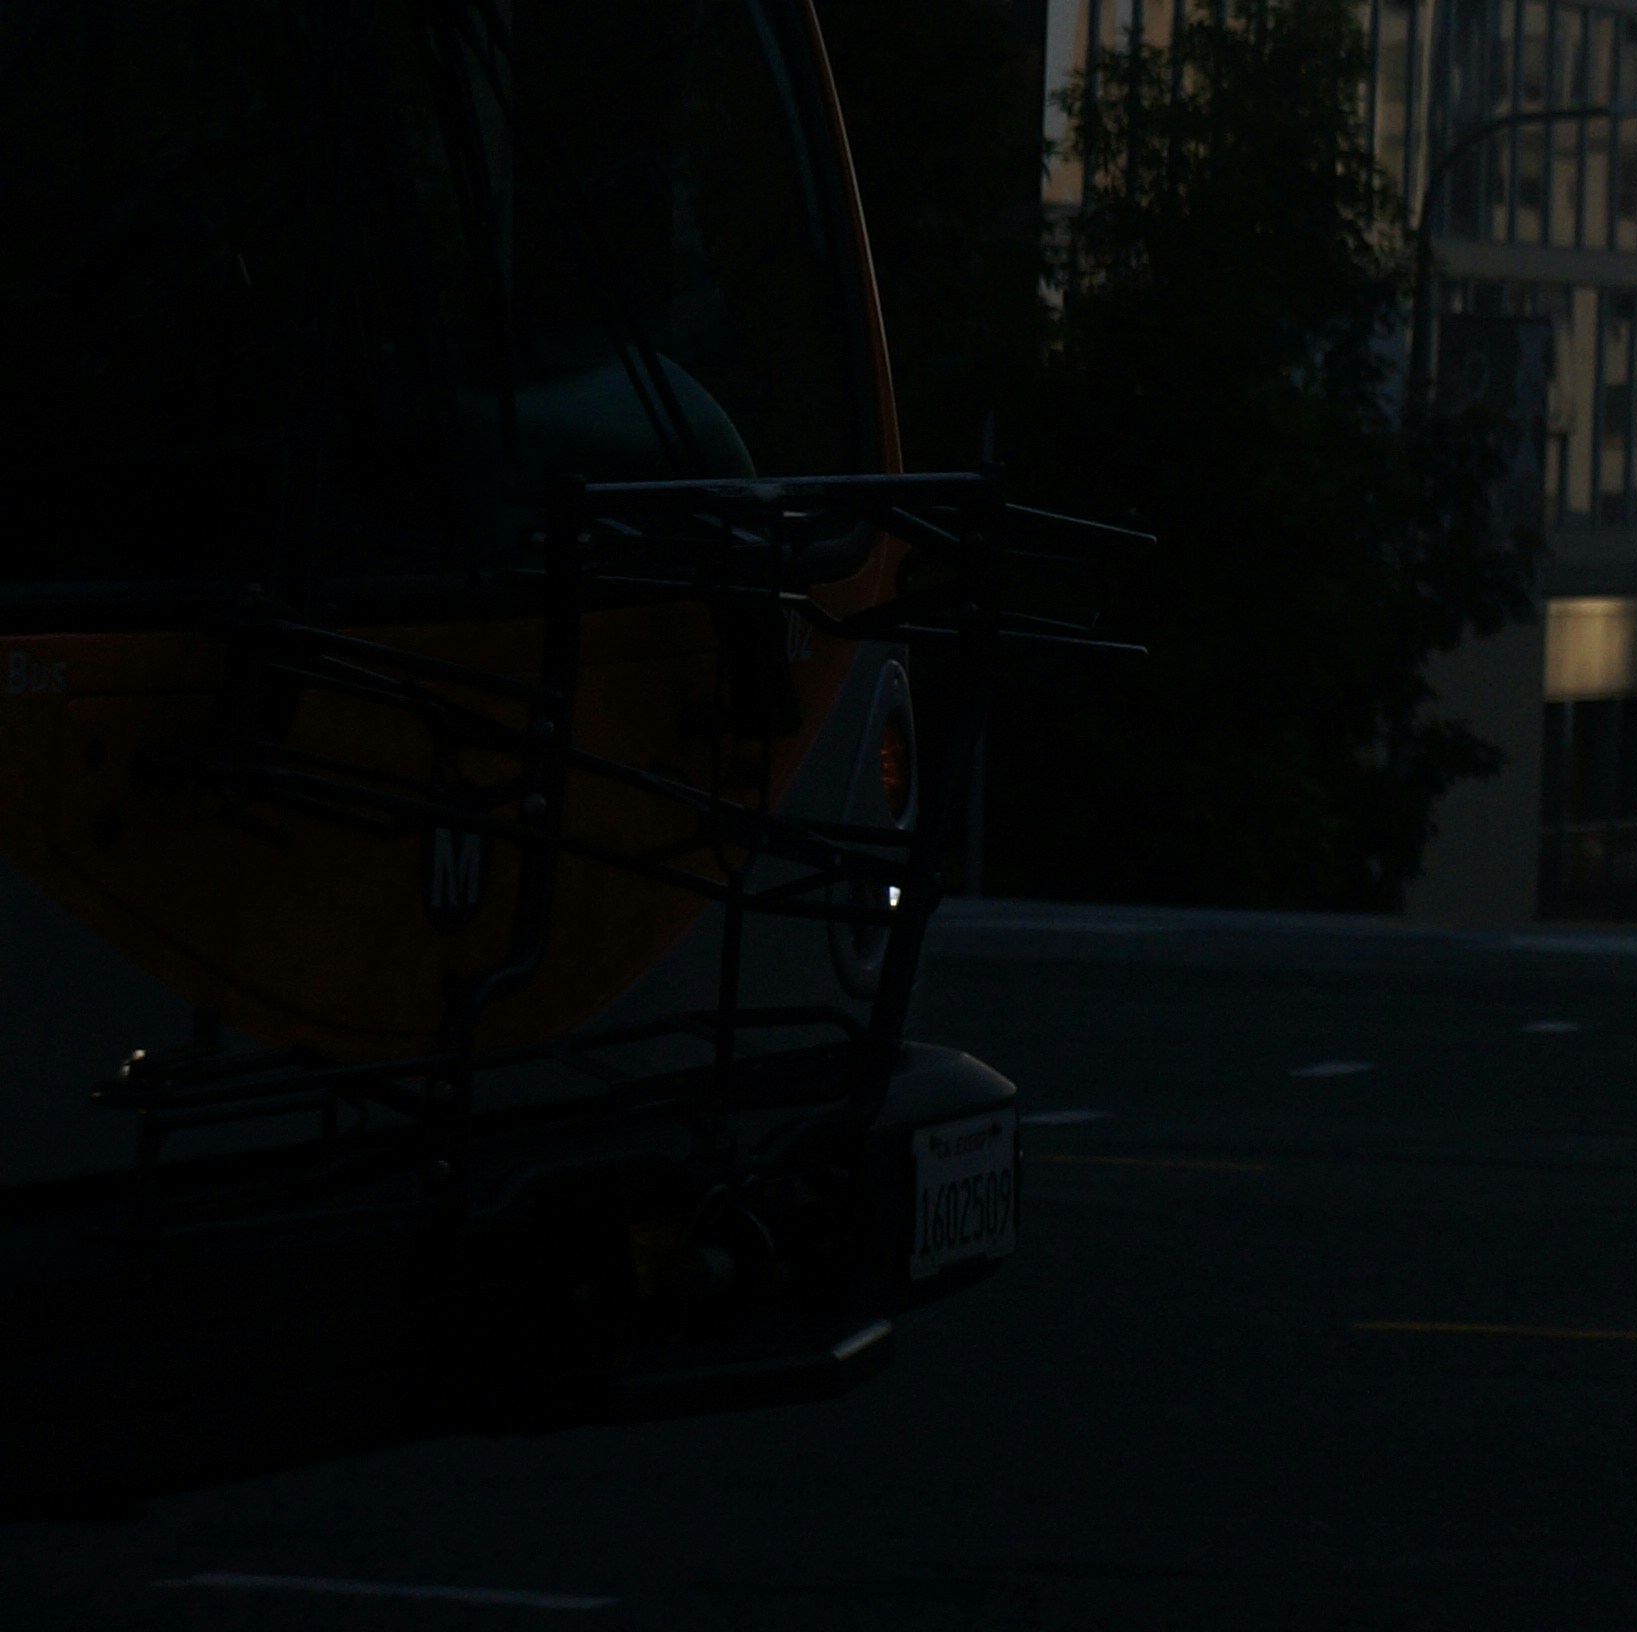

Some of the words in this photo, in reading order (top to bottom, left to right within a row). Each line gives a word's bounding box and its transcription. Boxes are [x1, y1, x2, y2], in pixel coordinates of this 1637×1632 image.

[5, 650, 66, 694] Bus
[431, 827, 481, 908] M
[919, 1168, 1011, 1255] 1602509
